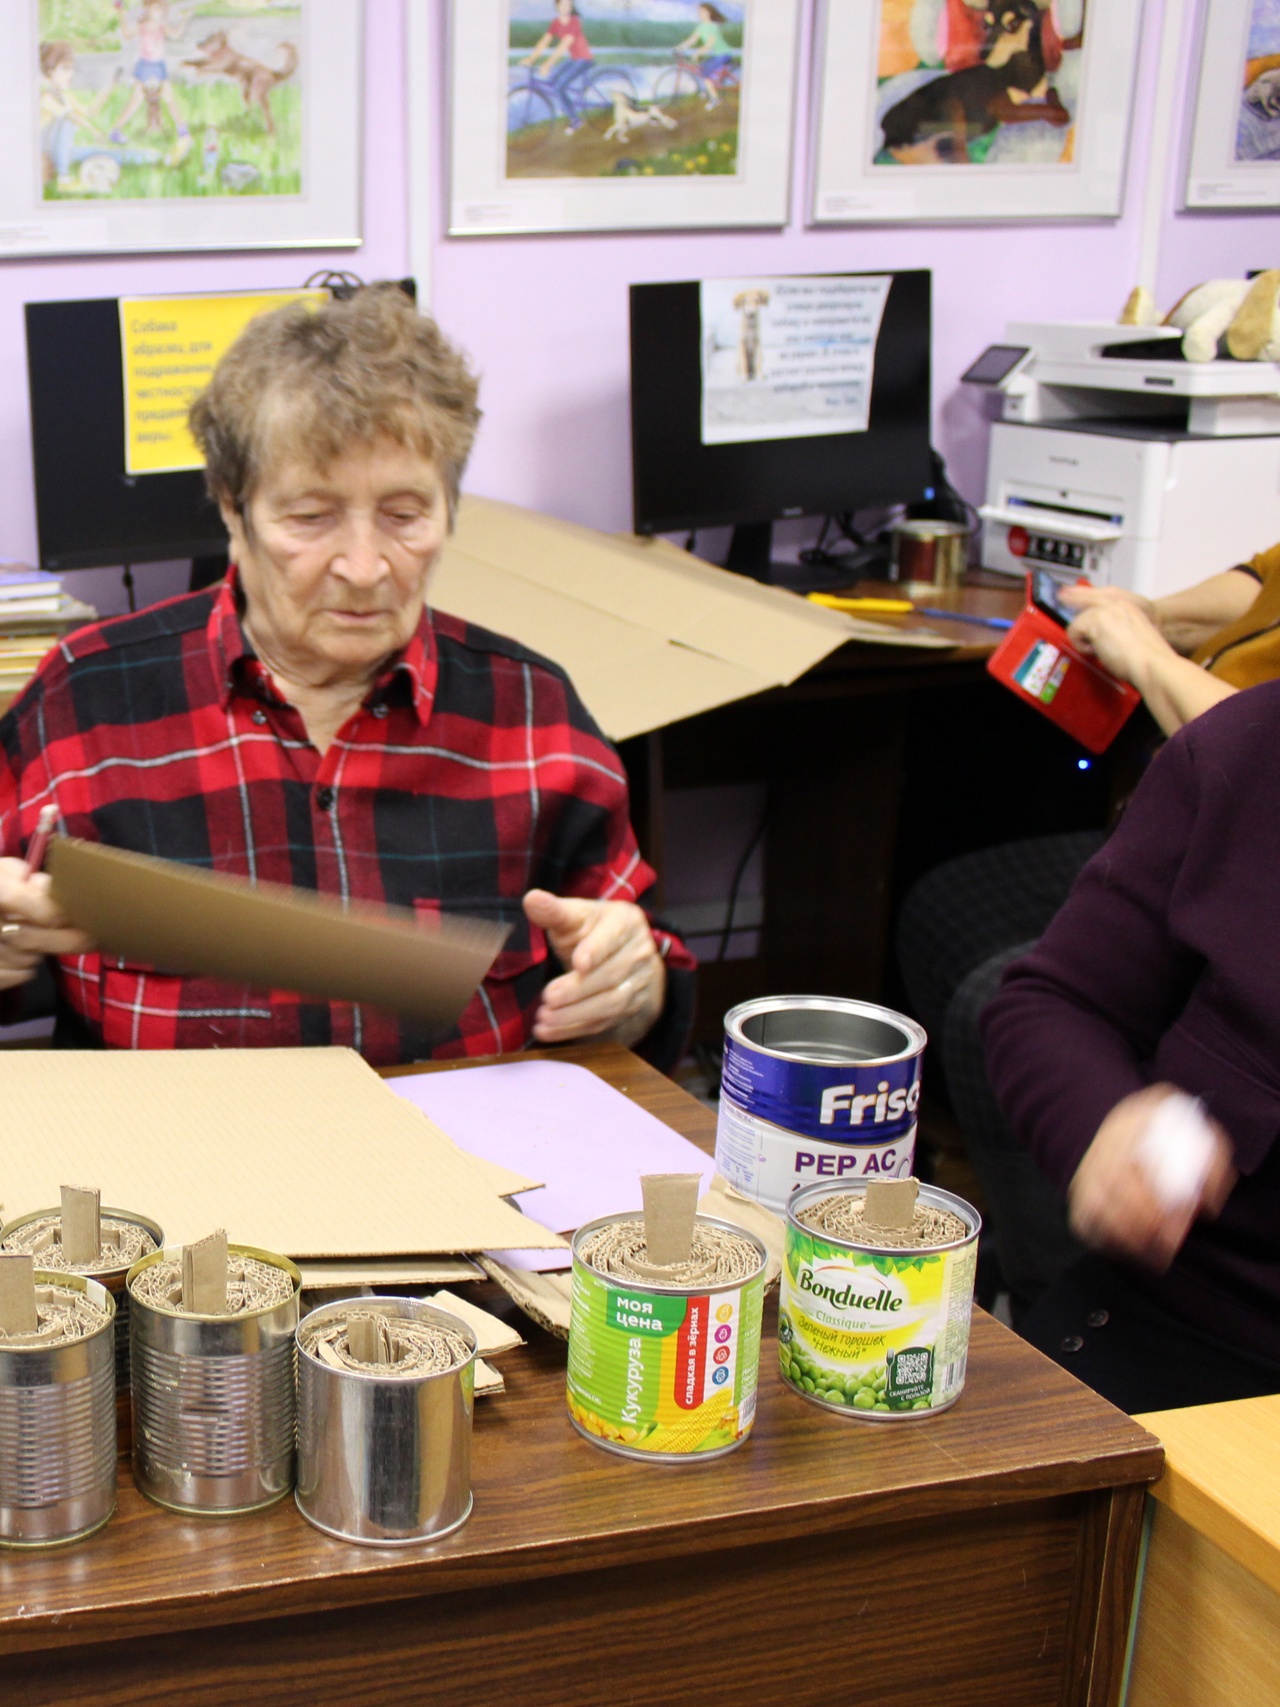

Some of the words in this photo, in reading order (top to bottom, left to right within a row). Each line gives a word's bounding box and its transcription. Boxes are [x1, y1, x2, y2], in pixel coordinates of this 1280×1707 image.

[819, 1080, 920, 1126] Friso
[795, 1151, 858, 1176] PEP
[861, 1148, 897, 1176] AC
[798, 1268, 904, 1313] Bonduelle
[686, 1306, 700, 1348] зёрнах
[815, 1310, 868, 1330] Classique
[839, 1333, 886, 1349] горошек
[688, 1349, 697, 1357] в
[621, 1337, 646, 1424] Кукуруза
[684, 1358, 698, 1405] сладкая
